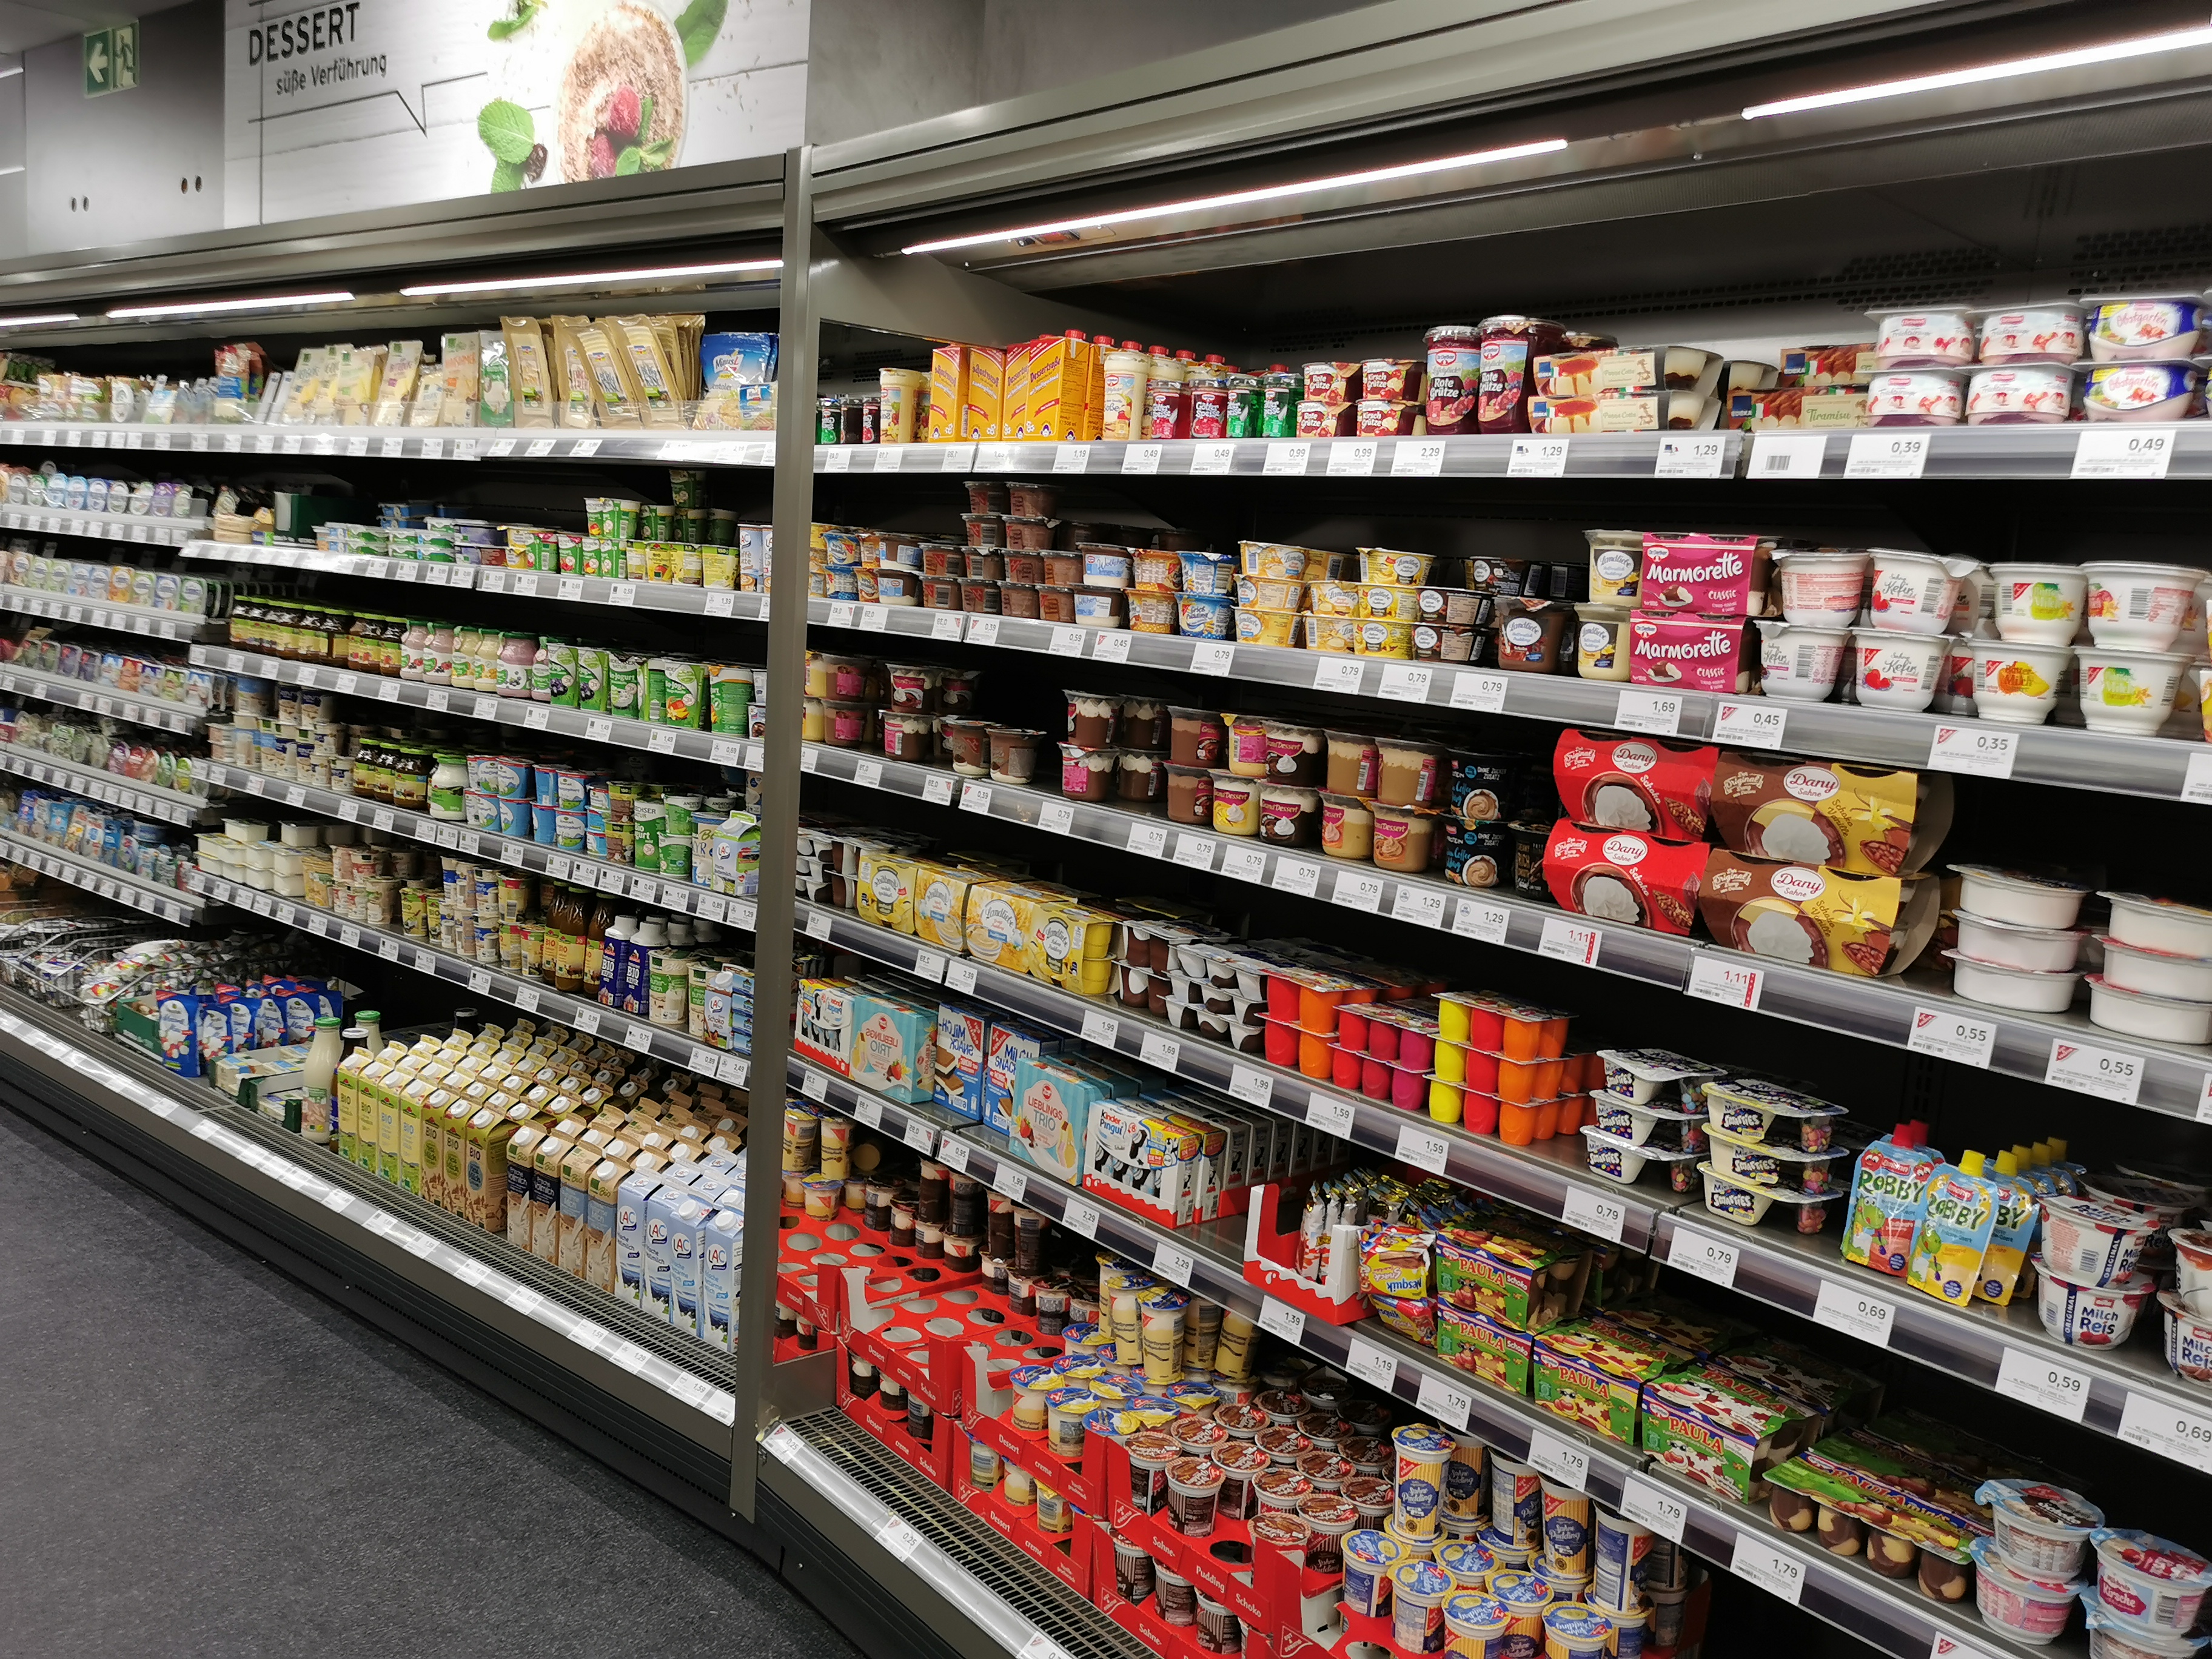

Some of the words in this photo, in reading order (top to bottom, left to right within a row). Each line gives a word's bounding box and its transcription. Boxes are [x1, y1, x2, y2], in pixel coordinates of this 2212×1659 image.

[248, 2, 360, 66] DESSERT
[276, 69, 307, 96] süße
[310, 52, 388, 87] Verführung
[1434, 377, 1455, 389] Rote
[1481, 370, 1498, 383] Rote
[1430, 386, 1459, 398] Grütze
[1806, 407, 1851, 422] Tiramisu
[1354, 448, 1372, 458] 0,99
[1421, 447, 1439, 458] 2,29
[1541, 446, 1563, 457] 1,29
[1694, 444, 1718, 456] 1,29
[1891, 441, 1921, 454] 0,39
[2128, 438, 2164, 453] 0,49
[1074, 450, 1086, 458] 1,19
[1144, 449, 1158, 458] 0,49
[1215, 449, 1230, 458] 0,49
[1289, 449, 1305, 458] 0,99
[1646, 551, 1743, 584] Marmorette
[1708, 589, 1737, 601] CLASSIC
[985, 623, 996, 631] 0,39
[1069, 633, 1082, 642] 0,59
[1113, 638, 1128, 648] 0,45
[1635, 630, 1731, 660] Marmorette
[1215, 650, 1230, 660] 0,79
[1341, 666, 1359, 677] 0,79
[1408, 672, 1427, 683] 0,79
[1697, 666, 1725, 678] CLASSIC
[1482, 680, 1503, 693] 0,79
[1652, 700, 1675, 713] 1,69
[1754, 712, 1780, 726] 0,45
[1977, 736, 2008, 752] 0,35
[1615, 748, 1656, 766] Dany
[1622, 761, 1642, 771] Sahne
[1640, 774, 1661, 805] Schoko
[1790, 773, 1836, 794] Dany
[977, 790, 989, 800] 0,39
[1797, 788, 1822, 798] Sahne
[1057, 809, 1071, 820] 0,79
[1831, 798, 1854, 828] Schoko
[1826, 806, 1849, 839] Vanille
[1148, 830, 1164, 842] 0,79
[1196, 842, 1212, 854] 0,79
[1606, 839, 1645, 859] Dany
[1247, 854, 1262, 866] 0,79
[1612, 853, 1632, 863] Sahne
[1299, 867, 1316, 879] 0,79
[1359, 881, 1378, 894] 0,79
[1629, 866, 1650, 897] Schoko
[1777, 872, 1822, 894] Dany
[1783, 886, 1807, 898] Sahne
[1421, 896, 1441, 909] 1,29
[743, 910, 754, 919] 1,29
[1483, 910, 1504, 925] 1,29
[1816, 899, 1836, 930] Schoko
[1811, 906, 1831, 939] Vanille
[1568, 928, 1590, 943] 1,11
[627, 965, 640, 979] BIO
[963, 970, 974, 980] 2,39
[1723, 970, 1749, 986] 1,11
[1101, 1021, 1115, 1032] 1,99
[1956, 1025, 1986, 1042] 0,55
[1162, 1044, 1176, 1056] 1,69
[734, 1062, 745, 1073] 2,49
[2099, 1058, 2134, 1076] 0,55
[1253, 1077, 1269, 1090] 1,99
[340, 1092, 351, 1105] BIO
[361, 1102, 372, 1114] BIO
[1028, 1095, 1064, 1121] LIEBLINGS
[1333, 1105, 1350, 1119] 1,59
[381, 1113, 392, 1125] BIO
[1033, 1109, 1056, 1131] TRIO
[1598, 1114, 1631, 1130] SMARTIES
[1724, 1112, 1760, 1128] SMARTIES
[403, 1122, 414, 1135] BIO
[425, 1127, 437, 1139] BIO
[447, 1137, 459, 1150] BIO
[1425, 1139, 1444, 1154] 1,59
[469, 1147, 481, 1161] BIO
[955, 1147, 967, 1158] 0,95
[1589, 1150, 1620, 1165] SMARTIES
[1734, 1159, 1777, 1174] SMARTIES
[1011, 1175, 1025, 1187] 1,99
[1857, 1168, 1926, 1205] ROBBY
[1712, 1191, 1754, 1208] SMARTIES
[618, 1210, 636, 1225] LAC
[1082, 1210, 1096, 1224] 2,29
[1596, 1204, 1618, 1221] 0,79
[1927, 1192, 1986, 1232] ROBBY
[648, 1224, 667, 1238] LAC
[672, 1238, 691, 1253] LAC
[708, 1249, 727, 1264] LAC
[1175, 1256, 1190, 1270] 2,29
[1706, 1246, 1732, 1265] 0,79
[2103, 1238, 2121, 1279] ORIGINAL
[1459, 1258, 1506, 1288] PAULA
[1506, 1275, 1528, 1292] Schoko
[1857, 1301, 1886, 1320] 0,69
[2064, 1295, 2076, 1334] ORIGINAL
[2082, 1306, 2119, 1322] Milch
[1284, 1312, 1301, 1327] 1,39
[2079, 1317, 2116, 1335] Reis
[1460, 1322, 1506, 1352] PAULA
[868, 1344, 886, 1363] Dessert
[1506, 1339, 1529, 1357] Schoko
[1374, 1356, 1393, 1371] 1,19
[897, 1367, 912, 1382] creme
[2048, 1371, 2081, 1393] 0,59
[1558, 1366, 1611, 1400] PAULA
[920, 1382, 937, 1402] Schoko
[1447, 1393, 1466, 1410] 1,79
[866, 1414, 883, 1434] Dessert
[2176, 1420, 2212, 1443] 0,69
[1669, 1416, 1724, 1456] PAULA
[786, 1438, 799, 1450] 0,25
[895, 1439, 910, 1455] creme
[999, 1433, 1019, 1455] Dessert
[919, 1456, 937, 1478] Schoko
[1561, 1451, 1584, 1469] 1,79
[1034, 1461, 1053, 1477] creme
[1832, 1468, 1906, 1506] PAULA
[1401, 1493, 1433, 1505] Pudding
[1657, 1500, 1681, 1519] 1,79
[990, 1510, 1011, 1533] Dessert
[901, 1530, 917, 1548] 0,25
[1549, 1530, 1581, 1541] Pudding
[1025, 1540, 1043, 1558] creme
[1153, 1536, 1176, 1558] Sahne-
[1771, 1557, 1798, 1580] 1,79
[1196, 1564, 1225, 1594] Pudding
[2102, 1583, 2136, 1607] Kirsche
[1235, 1593, 1262, 1618] Schoko
[1138, 1623, 1162, 1646] Sahne-
